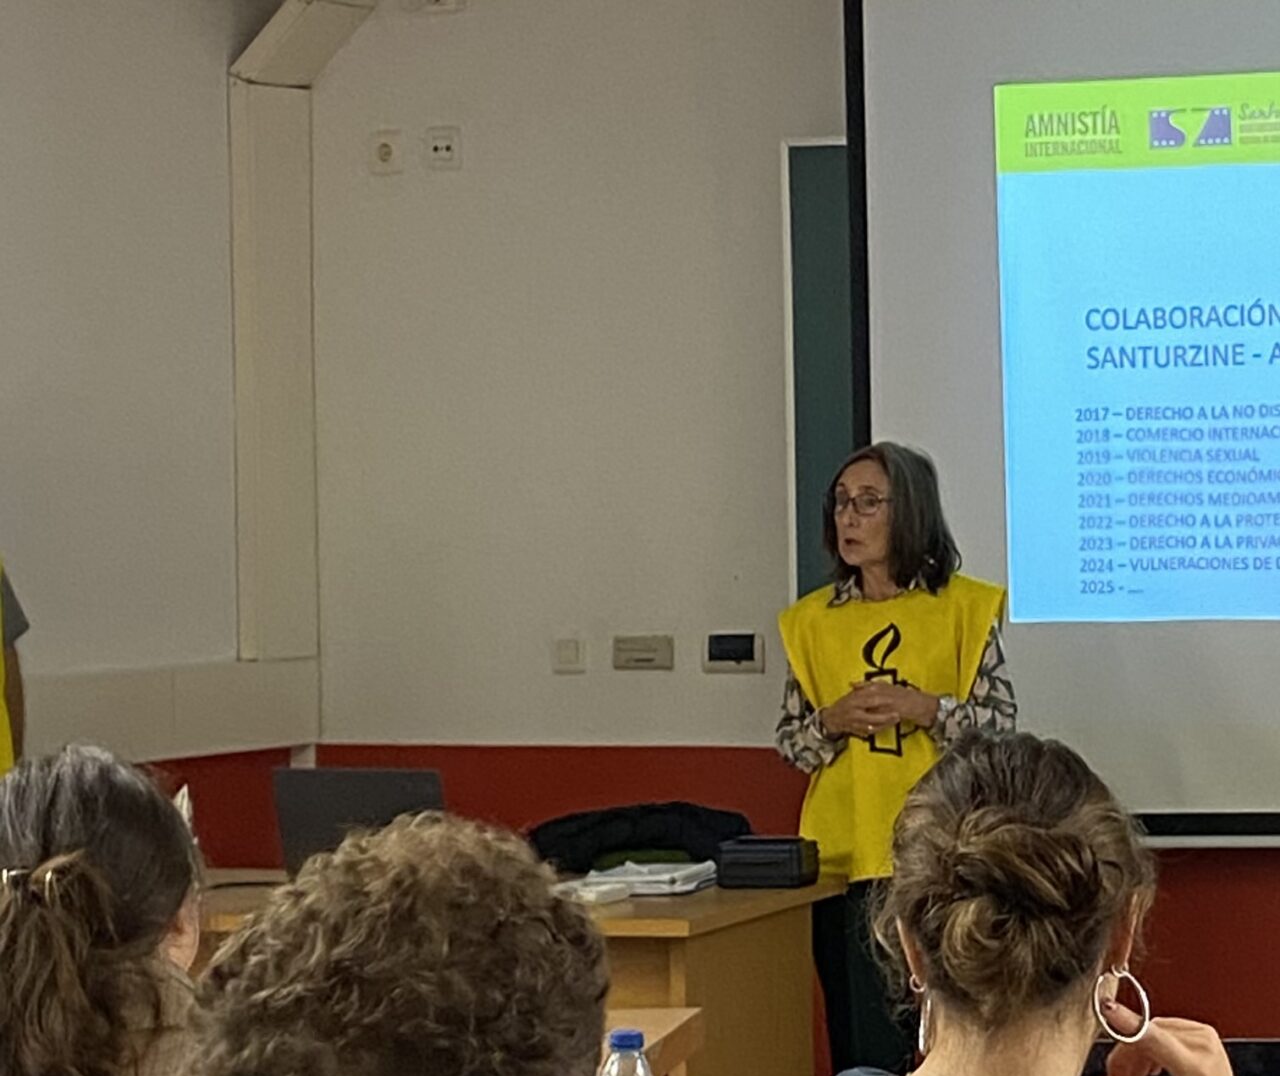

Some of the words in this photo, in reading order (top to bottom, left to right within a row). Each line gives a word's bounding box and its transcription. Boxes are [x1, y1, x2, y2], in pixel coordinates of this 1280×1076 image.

[1025, 105, 1120, 138] AMNISTÍA
[1025, 138, 1122, 157] INTERNACIONAL
[1086, 343, 1245, 369] SANTURZINE
[1075, 407, 1110, 422] 2017
[1125, 406, 1194, 421] DERECHO
[1197, 405, 1208, 420] A
[1211, 405, 1230, 420] LA
[1232, 404, 1255, 419] NO
[1076, 428, 1110, 444] 2018
[1126, 427, 1204, 442] COMERCIO
[1077, 450, 1111, 465] 2019
[1126, 448, 1203, 463] VIOLENCIA
[1206, 447, 1260, 462] SEXUAL
[1077, 471, 1112, 486] 2020
[1127, 470, 1203, 485] DERECHOS
[1078, 494, 1112, 508] 2021
[1128, 492, 1202, 507] DERECHOS
[1078, 515, 1112, 530] 2022
[1129, 514, 1196, 528] DERECHO
[1200, 514, 1211, 528] A
[1214, 514, 1232, 528] LA
[1079, 537, 1113, 551] 2023
[1130, 535, 1197, 550] DERECHO
[1201, 535, 1211, 549] A
[1215, 535, 1233, 549] LA
[1080, 558, 1114, 572] 2024
[1129, 556, 1249, 571] VULNERACIONES
[1253, 556, 1272, 570] DE
[1080, 580, 1115, 594] 2025
